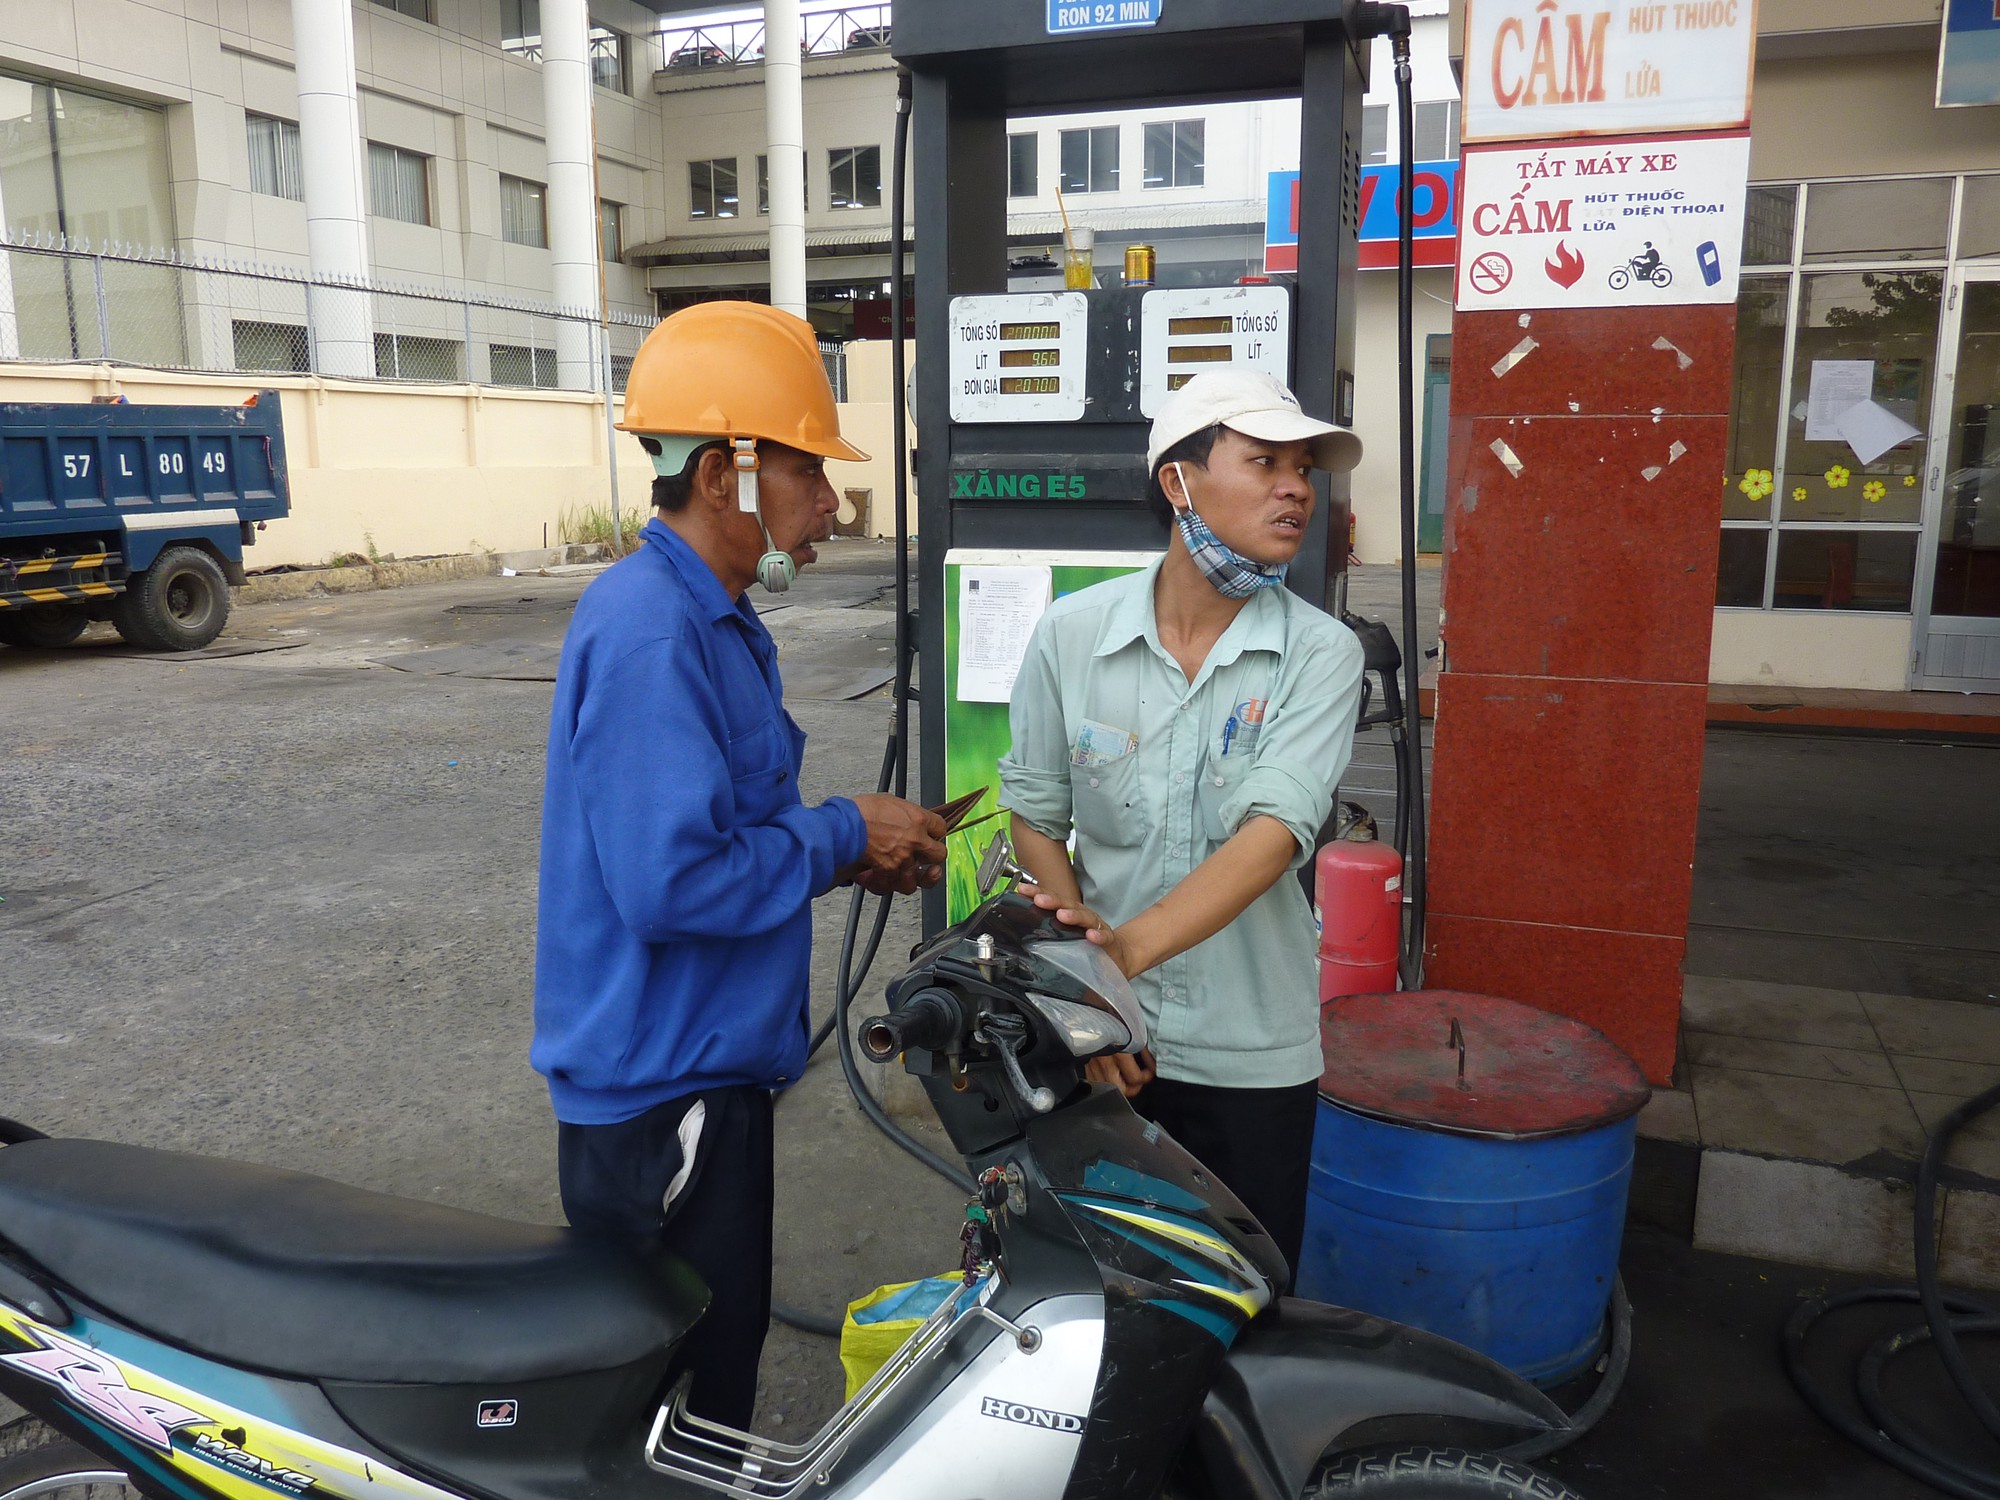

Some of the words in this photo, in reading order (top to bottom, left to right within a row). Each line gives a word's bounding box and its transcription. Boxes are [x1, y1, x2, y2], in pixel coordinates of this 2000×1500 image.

[1058, 7, 1090, 26] RON
[1095, 4, 1115, 23] 92
[1120, 1, 1149, 21] MIN
[1517, 152, 1566, 179] TẮT
[1575, 151, 1632, 176] MÁY
[1640, 153, 1677, 172] XE
[1584, 192, 1619, 204] HÚT
[1625, 188, 1685, 202] THUỐC
[1472, 182, 1573, 236] CẤM
[1623, 204, 1665, 217] ĐIỆN
[1670, 204, 1725, 215] THOẠI
[1583, 219, 1616, 232] LỬA
[986, 320, 998, 341] SỐ
[1236, 310, 1263, 333] TỔNG
[1264, 309, 1279, 332] SỐ
[975, 350, 988, 370] LÍT
[1248, 339, 1262, 359] LÍT
[984, 374, 999, 394] GIÁ
[1015, 378, 1058, 392] 20700
[64, 454, 91, 478] 57
[120, 454, 133, 477] L
[159, 452, 184, 475] 80
[203, 452, 226, 473] 49
[953, 469, 1041, 499] XĂNG
[1048, 475, 1087, 499] E5
[982, 1398, 1085, 1434] HOND
[192, 1446, 225, 1463] URBAN
[226, 1461, 266, 1479] SPORTY
[267, 1478, 303, 1494] MOVER
